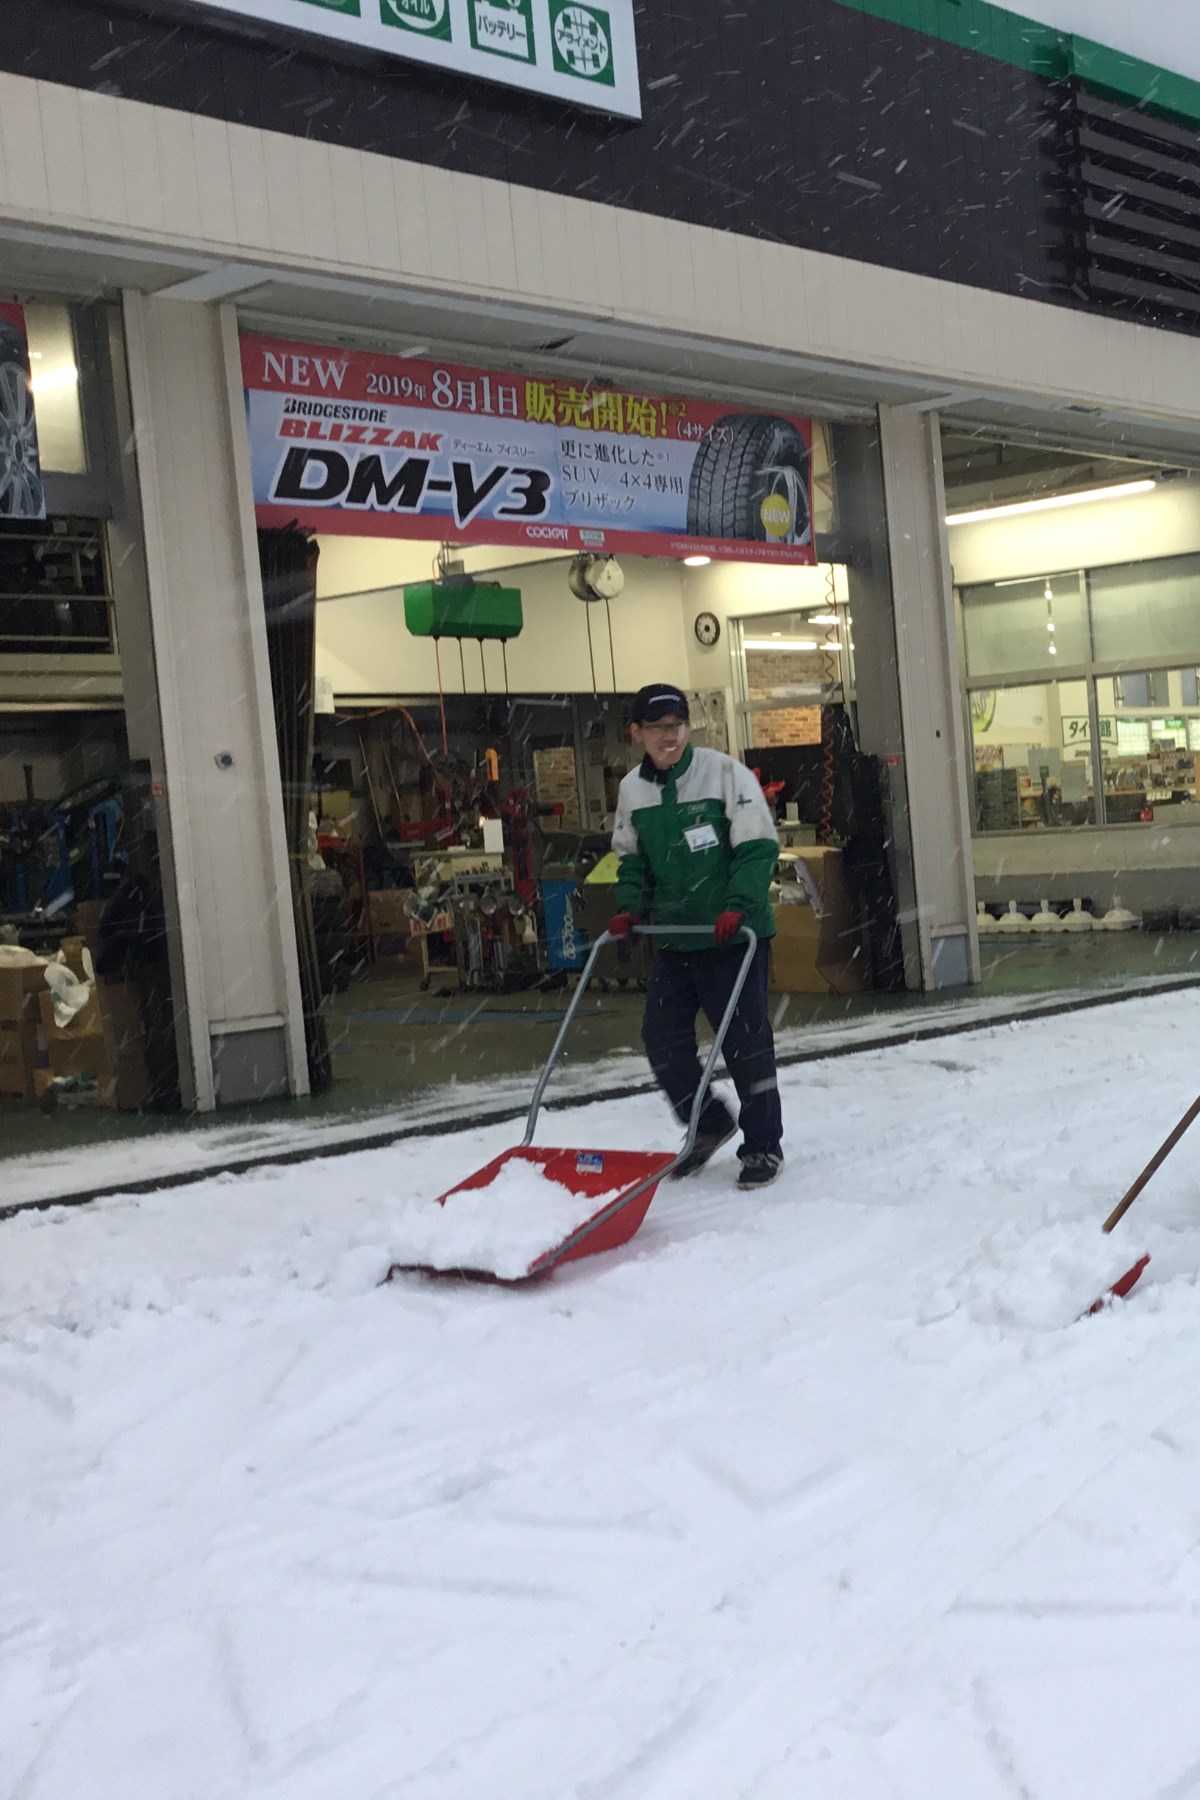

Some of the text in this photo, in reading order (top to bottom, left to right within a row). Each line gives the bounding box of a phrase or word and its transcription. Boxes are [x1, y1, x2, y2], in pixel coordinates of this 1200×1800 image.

[478, 14, 526, 41] バッテリー
[557, 30, 607, 54] アライメント
[262, 351, 349, 391] NEW
[283, 397, 388, 423] BRIDGESTONE
[279, 418, 444, 451] BLIZZAK
[274, 448, 551, 523] DM-V3
[565, 490, 636, 511] ブリザック
[764, 508, 791, 524] NEW
[525, 525, 569, 540] COCKPIT
[1069, 718, 1112, 739] タイ館
